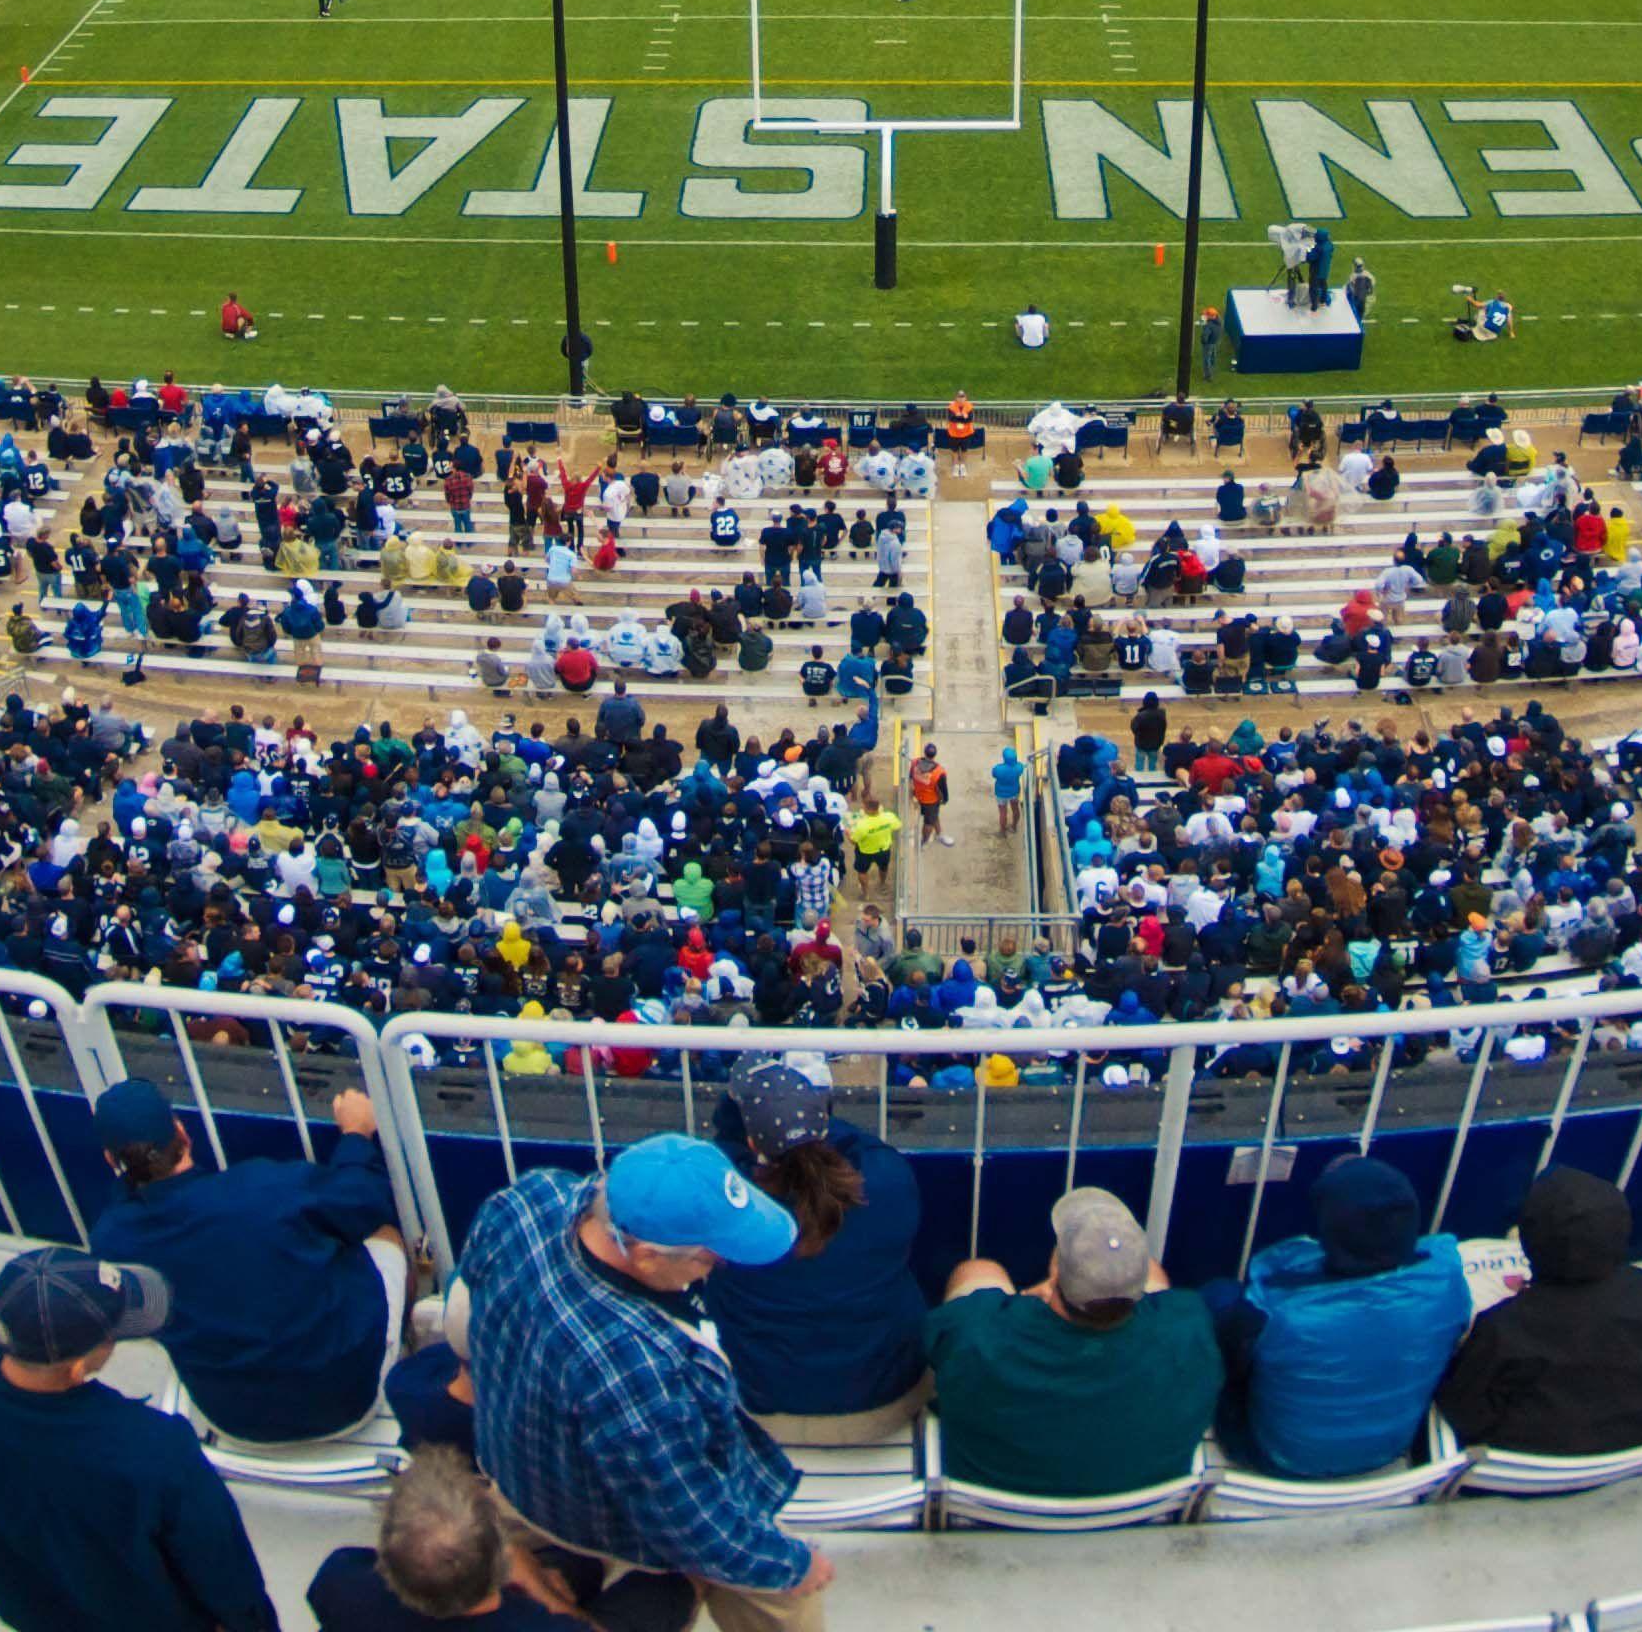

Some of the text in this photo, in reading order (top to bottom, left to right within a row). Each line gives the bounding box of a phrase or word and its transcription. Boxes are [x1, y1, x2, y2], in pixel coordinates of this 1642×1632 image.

[853, 414, 871, 428] NF
[28, 471, 45, 490] 12
[386, 477, 404, 492] 25
[716, 517, 735, 536] 22
[70, 555, 86, 573] 11
[1124, 645, 1140, 664] 11
[1095, 881, 1108, 902] 6
